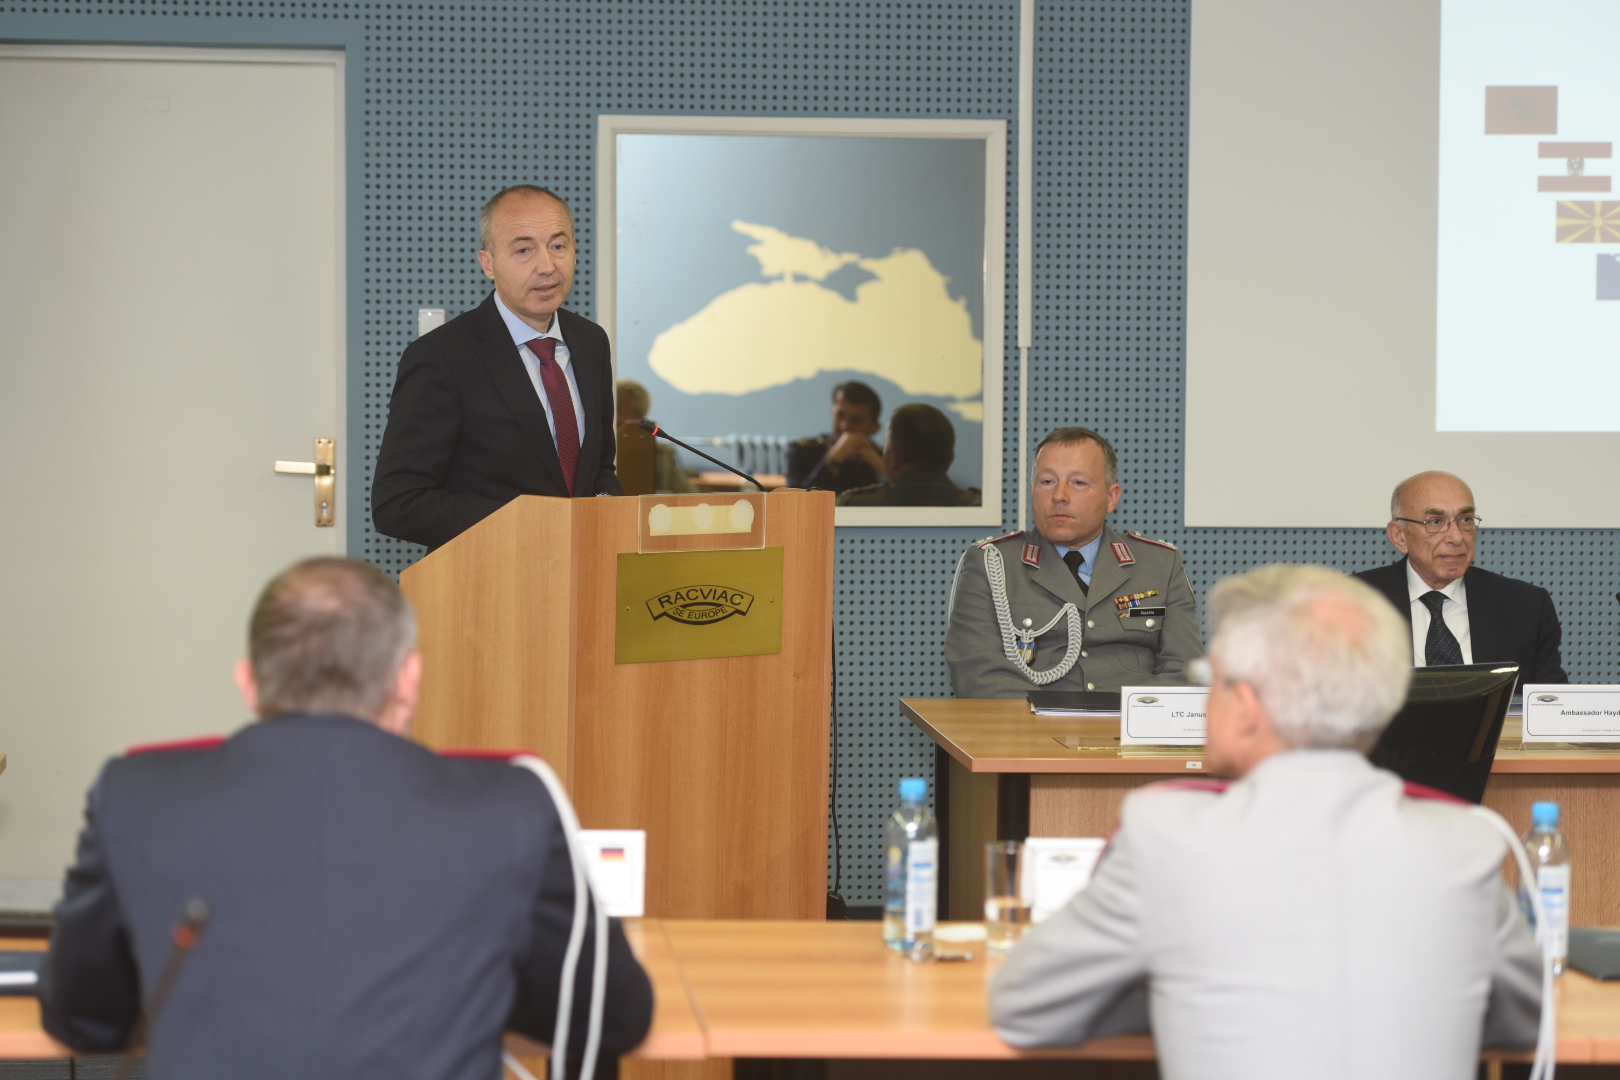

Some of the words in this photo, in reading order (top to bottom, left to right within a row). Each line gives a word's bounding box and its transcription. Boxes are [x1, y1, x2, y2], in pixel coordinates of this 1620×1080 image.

[657, 588, 744, 609] RACVIAC
[672, 607, 686, 618] SE
[687, 606, 728, 620] EUROPE
[1603, 709, 1620, 718] Hayd
